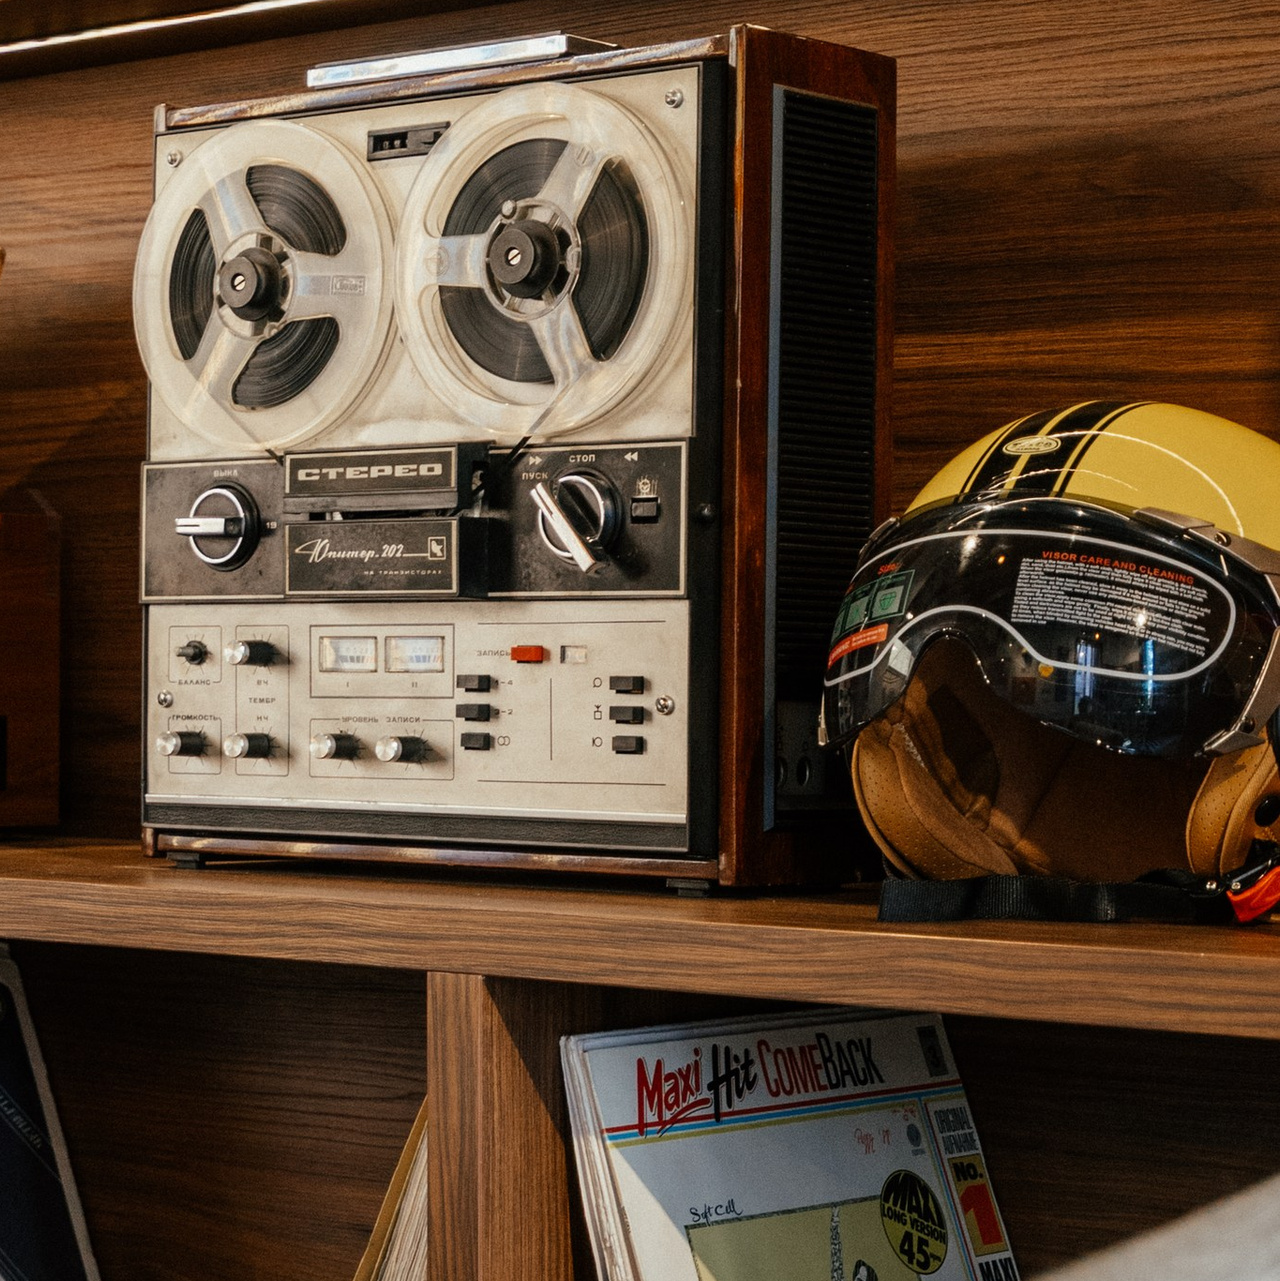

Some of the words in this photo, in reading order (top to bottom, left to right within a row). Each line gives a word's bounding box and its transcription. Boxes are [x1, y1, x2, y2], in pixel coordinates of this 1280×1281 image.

[298, 463, 443, 482] СТЕРЕО
[569, 453, 596, 463] СТОП
[521, 470, 548, 481] ПУСК
[1042, 551, 1077, 562] VISOR
[1080, 554, 1111, 567] CARE
[1113, 560, 1137, 572] AND
[1139, 565, 1195, 585] CLEANING
[341, 716, 379, 724] УРОВЕНЬ
[386, 716, 421, 724] ЗАПИСИ
[636, 1047, 705, 1134] Maxi
[707, 1044, 758, 1122] Hit
[933, 1106, 973, 1134] ORIGINAL
[952, 1162, 984, 1182] No.
[689, 1203, 714, 1227] Soft
[715, 1198, 744, 1216] Cell
[883, 1169, 946, 1230] MAXI
[883, 1203, 907, 1227] LONG
[909, 1215, 947, 1245] VERSION
[960, 1183, 1003, 1246] 1
[899, 1230, 931, 1271] 45
